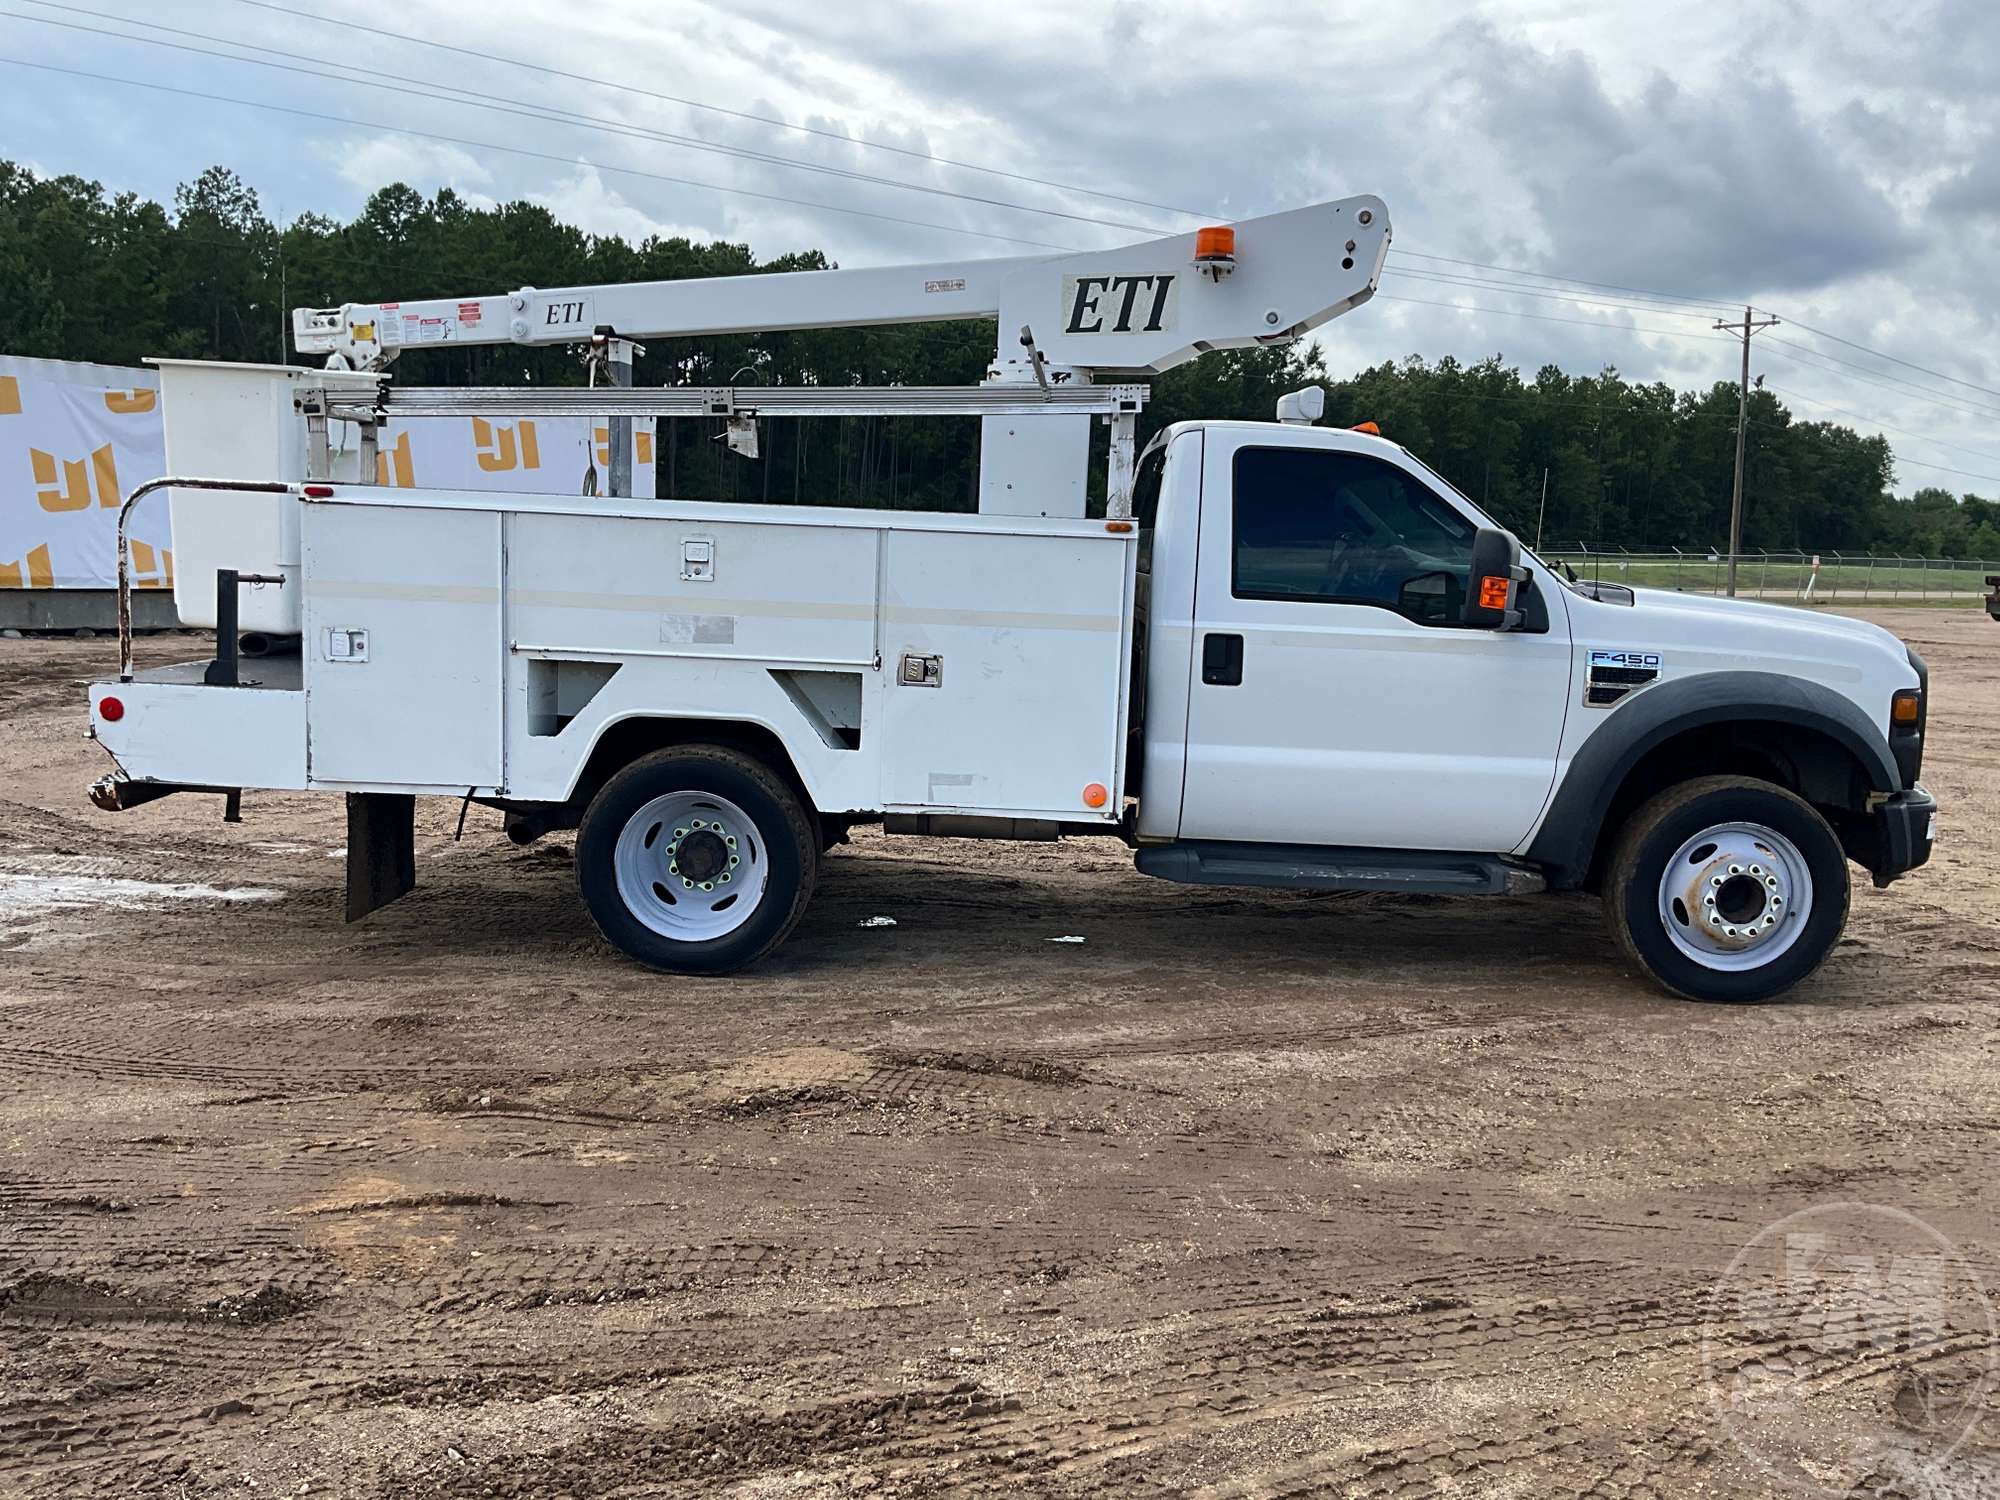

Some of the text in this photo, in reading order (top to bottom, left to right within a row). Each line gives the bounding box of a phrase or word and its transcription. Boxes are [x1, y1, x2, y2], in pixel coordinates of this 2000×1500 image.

[545, 302, 585, 324] ETI
[1065, 274, 1175, 333] ETI
[1592, 653, 1659, 665] F-450
